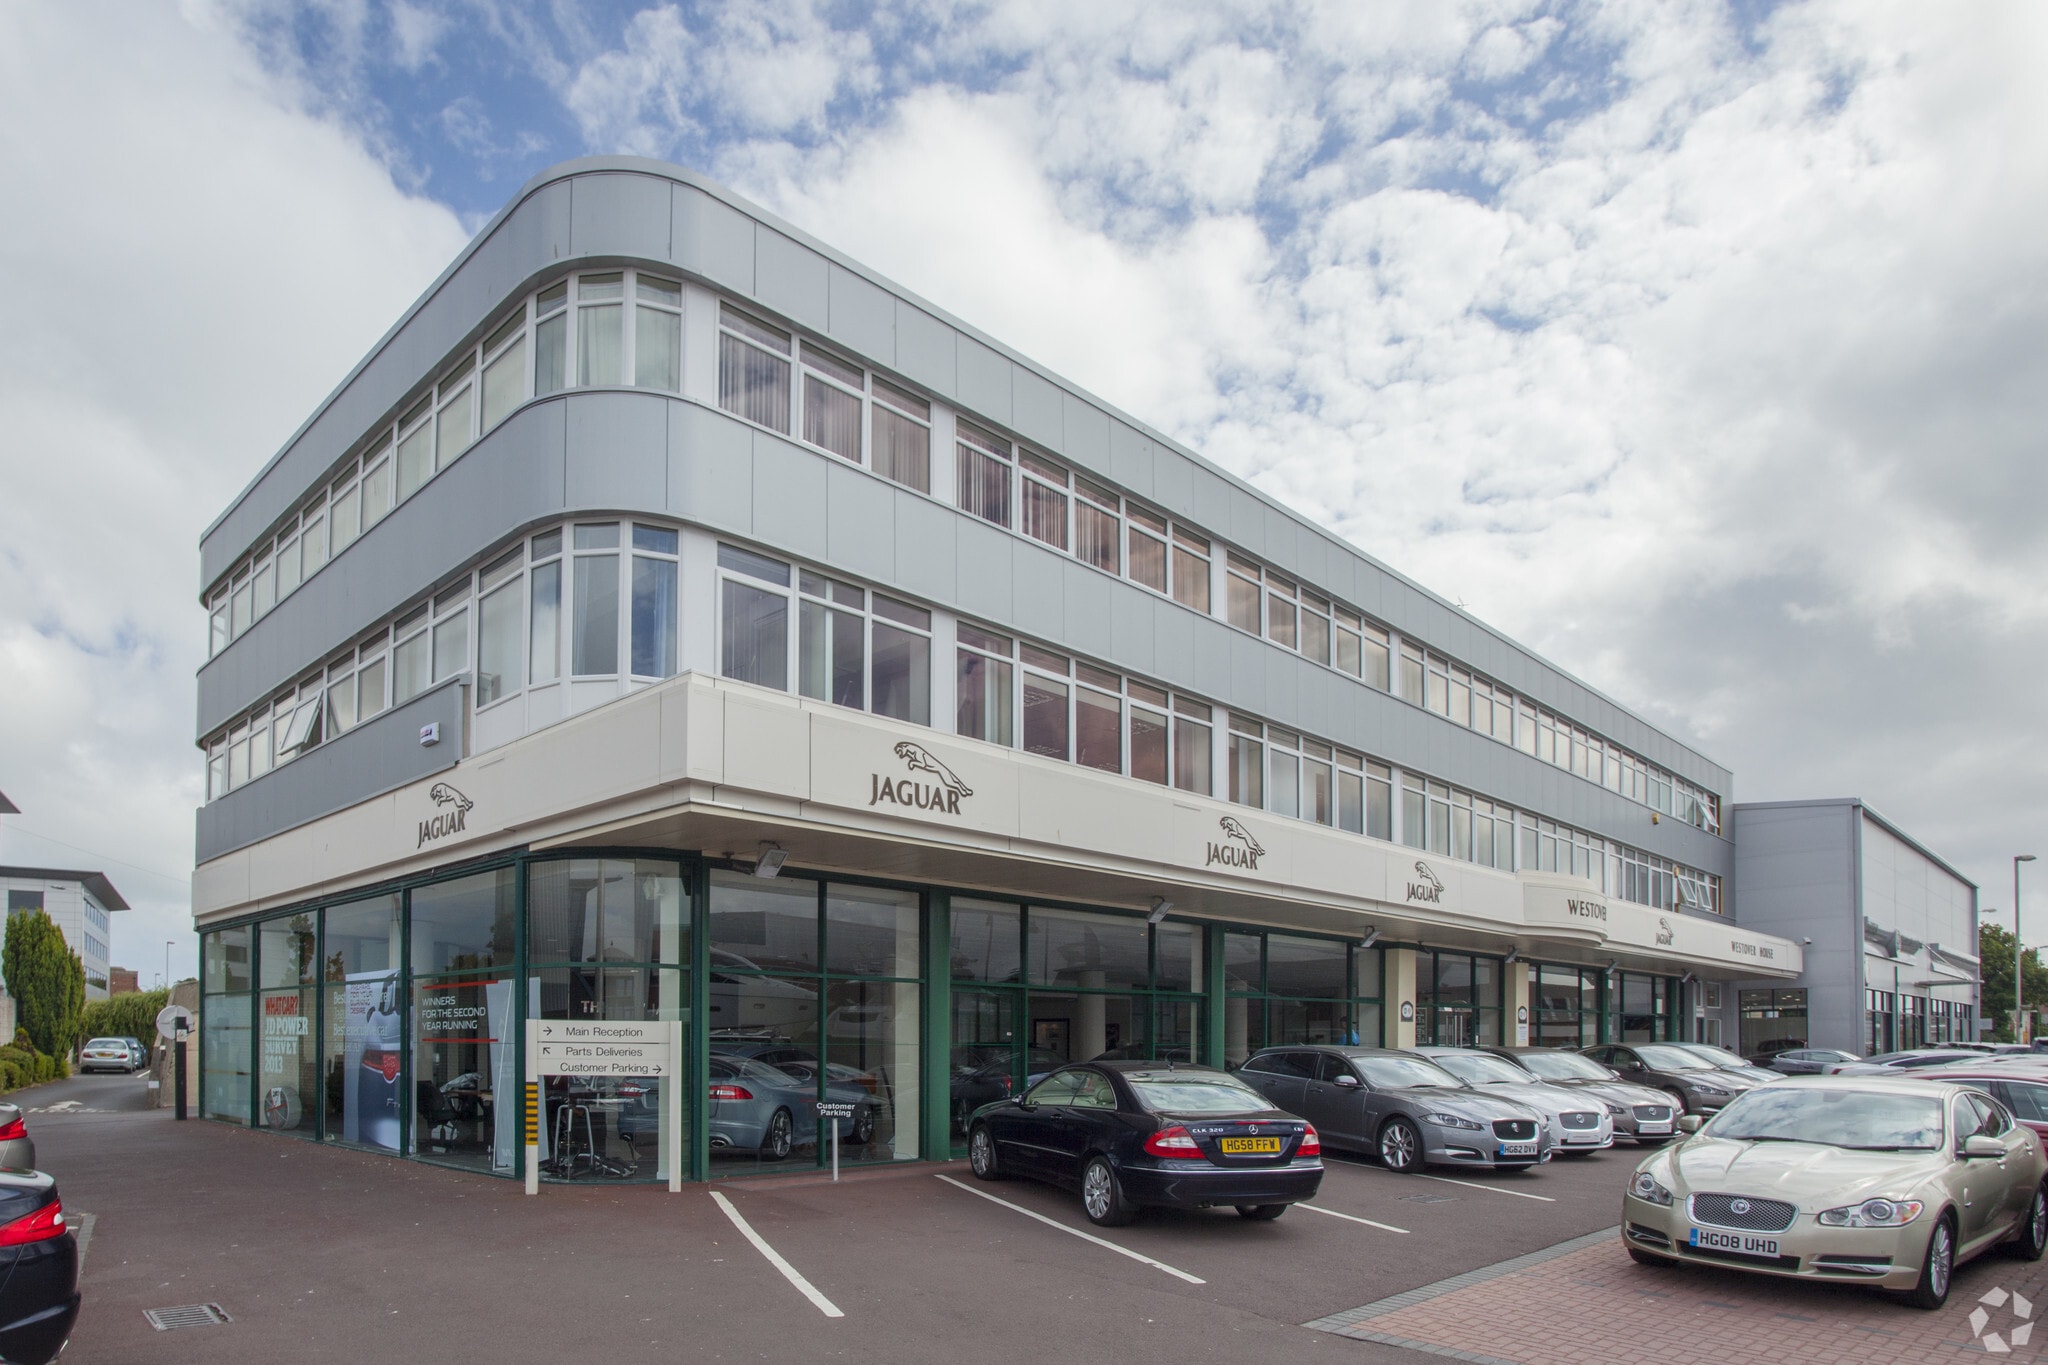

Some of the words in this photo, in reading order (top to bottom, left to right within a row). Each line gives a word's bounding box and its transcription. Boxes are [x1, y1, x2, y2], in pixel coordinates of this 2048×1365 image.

[868, 773, 961, 815] JAGUAR
[417, 809, 466, 849] JAGUAR
[1205, 841, 1258, 870] JAGUAR
[1406, 882, 1440, 903] JAGUAR
[1567, 899, 1607, 921] WESTOVE
[1655, 932, 1672, 945] JAGUAR
[1731, 941, 1756, 956] WESTOVER
[1759, 946, 1774, 959] HOUSE
[422, 996, 456, 1007] WINNERS
[422, 1009, 437, 1019] FOR
[438, 1008, 453, 1018] THE
[454, 1007, 486, 1017] SECOND
[265, 1016, 276, 1035] JD
[276, 1016, 309, 1035] POWER
[422, 1021, 442, 1031] YEAR
[443, 1020, 478, 1030] RUNNING
[565, 1027, 589, 1036] Main
[593, 1027, 643, 1038] Reception
[264, 1036, 298, 1055] SURVEY
[565, 1047, 592, 1056] Parts
[596, 1047, 643, 1057] Deliveries
[264, 1055, 283, 1074] 2013
[560, 1062, 607, 1072] Customer
[611, 1063, 649, 1074] Parking
[816, 1102, 855, 1110] Customer
[820, 1109, 852, 1118] Parking
[1226, 1139, 1253, 1151] HG58
[1255, 1139, 1275, 1150] FFW
[1504, 1145, 1523, 1153] HG62
[1700, 1231, 1740, 1249] HG08
[1744, 1237, 1777, 1253] UHD
